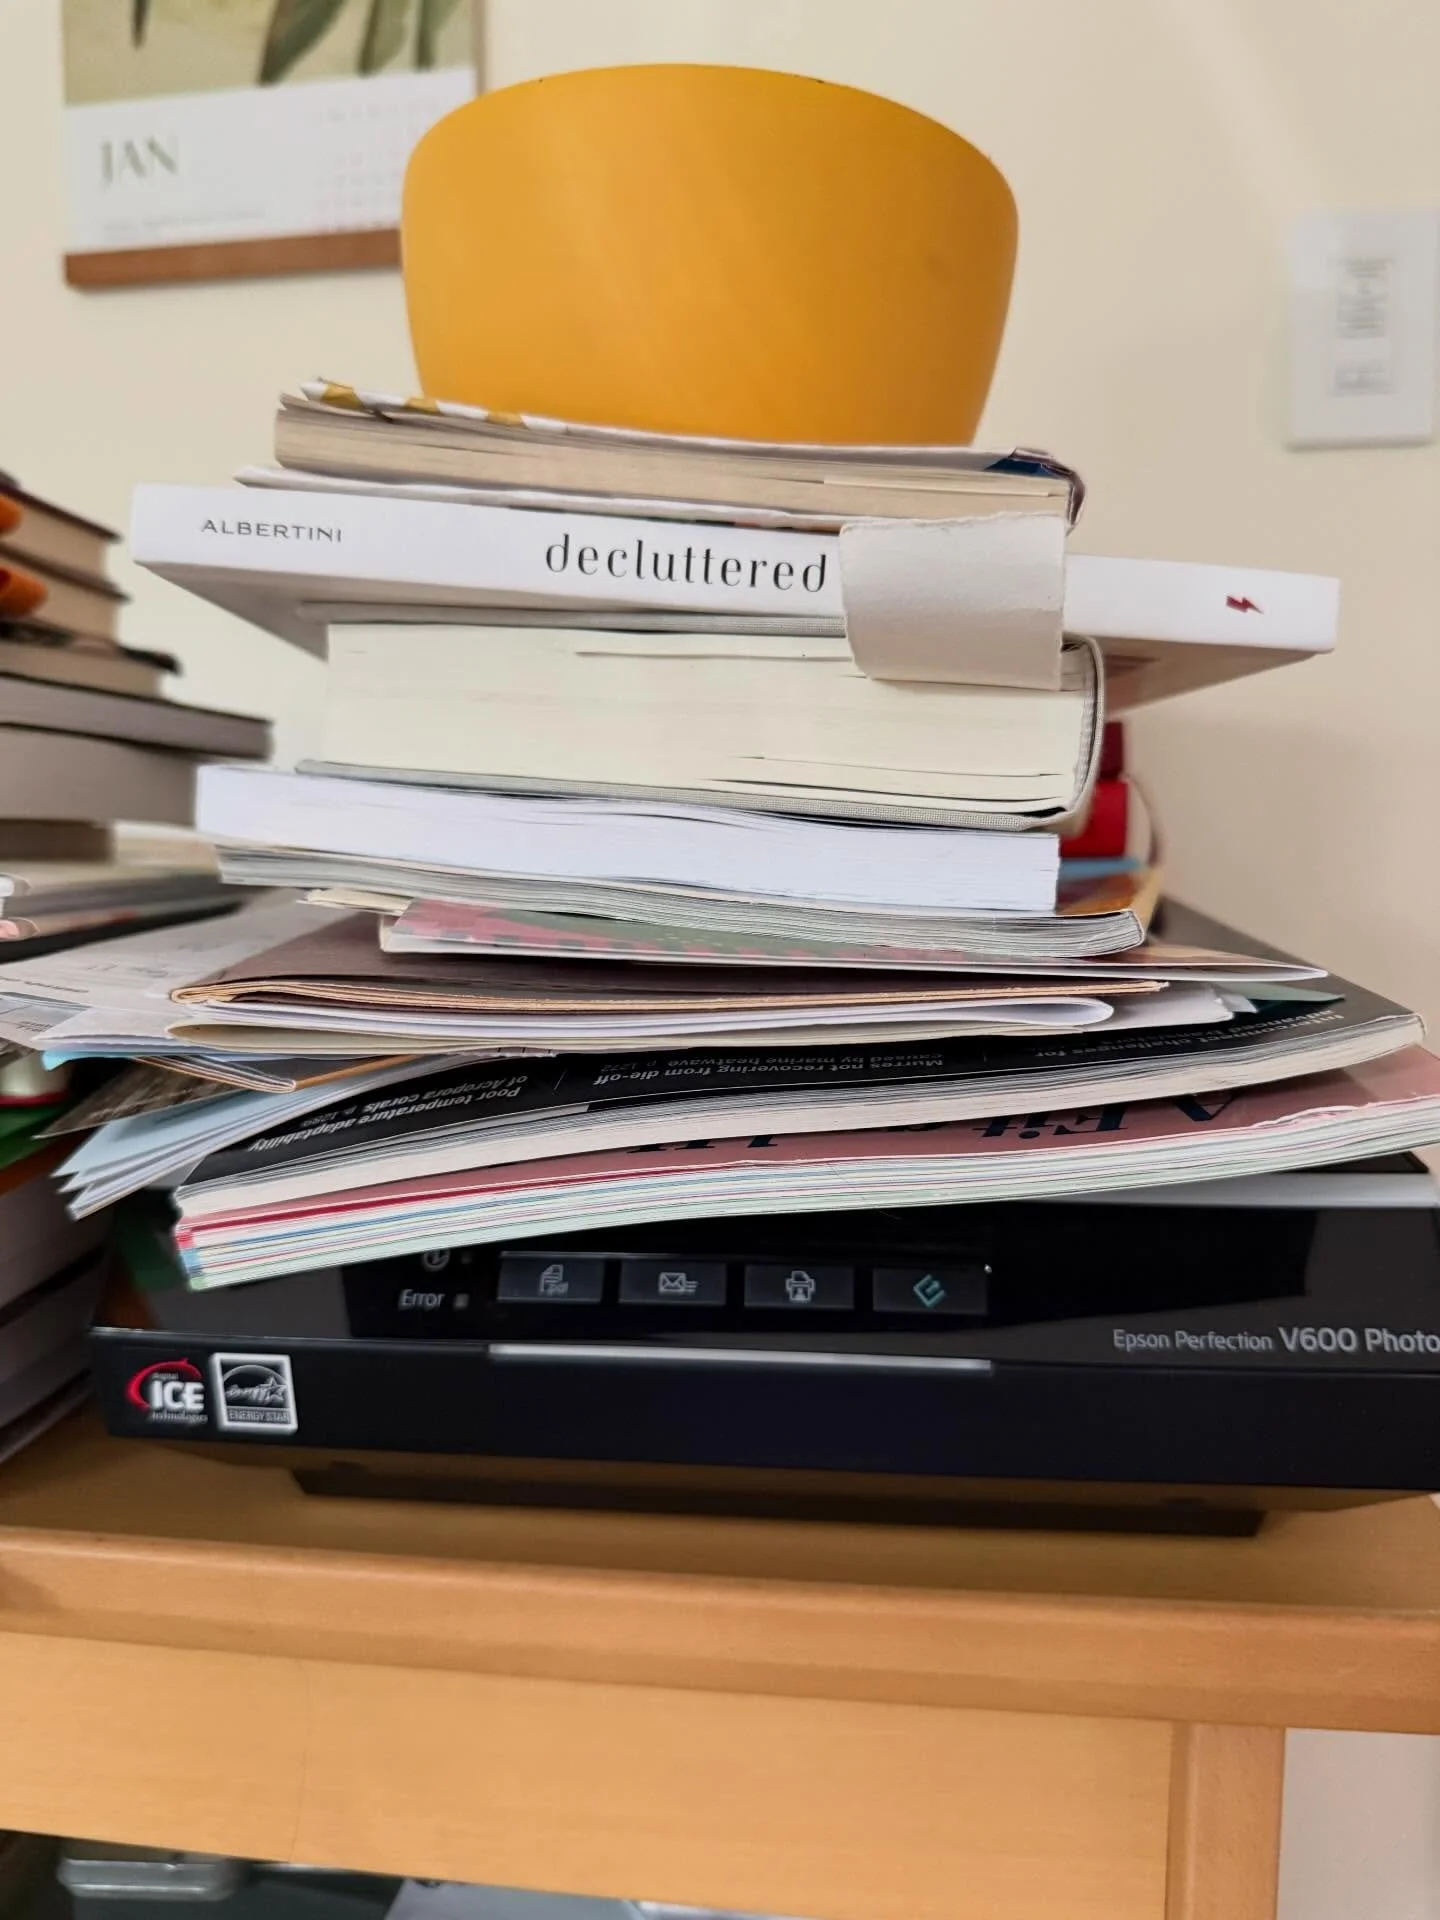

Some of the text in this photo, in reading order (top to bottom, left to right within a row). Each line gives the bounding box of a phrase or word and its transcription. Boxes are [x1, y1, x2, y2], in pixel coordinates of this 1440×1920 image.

[101, 136, 179, 190] JAN
[201, 519, 342, 542] ALBERTINI
[545, 533, 827, 592] decluttered
[667, 1058, 760, 1067] heatwave
[765, 1055, 835, 1064] marine
[841, 1056, 865, 1064] by
[870, 1052, 943, 1062] caused
[593, 1059, 943, 1086] Murres not recovering from die-off
[362, 1075, 528, 1114] of Acropora corals
[475, 1086, 521, 1101] Poor
[358, 1094, 473, 1124] temperature
[247, 1118, 357, 1152] adaptability
[401, 1288, 445, 1308] Error
[1112, 1327, 1440, 1353] Epson Perfection V600 Photo
[151, 1380, 205, 1412] ICE
